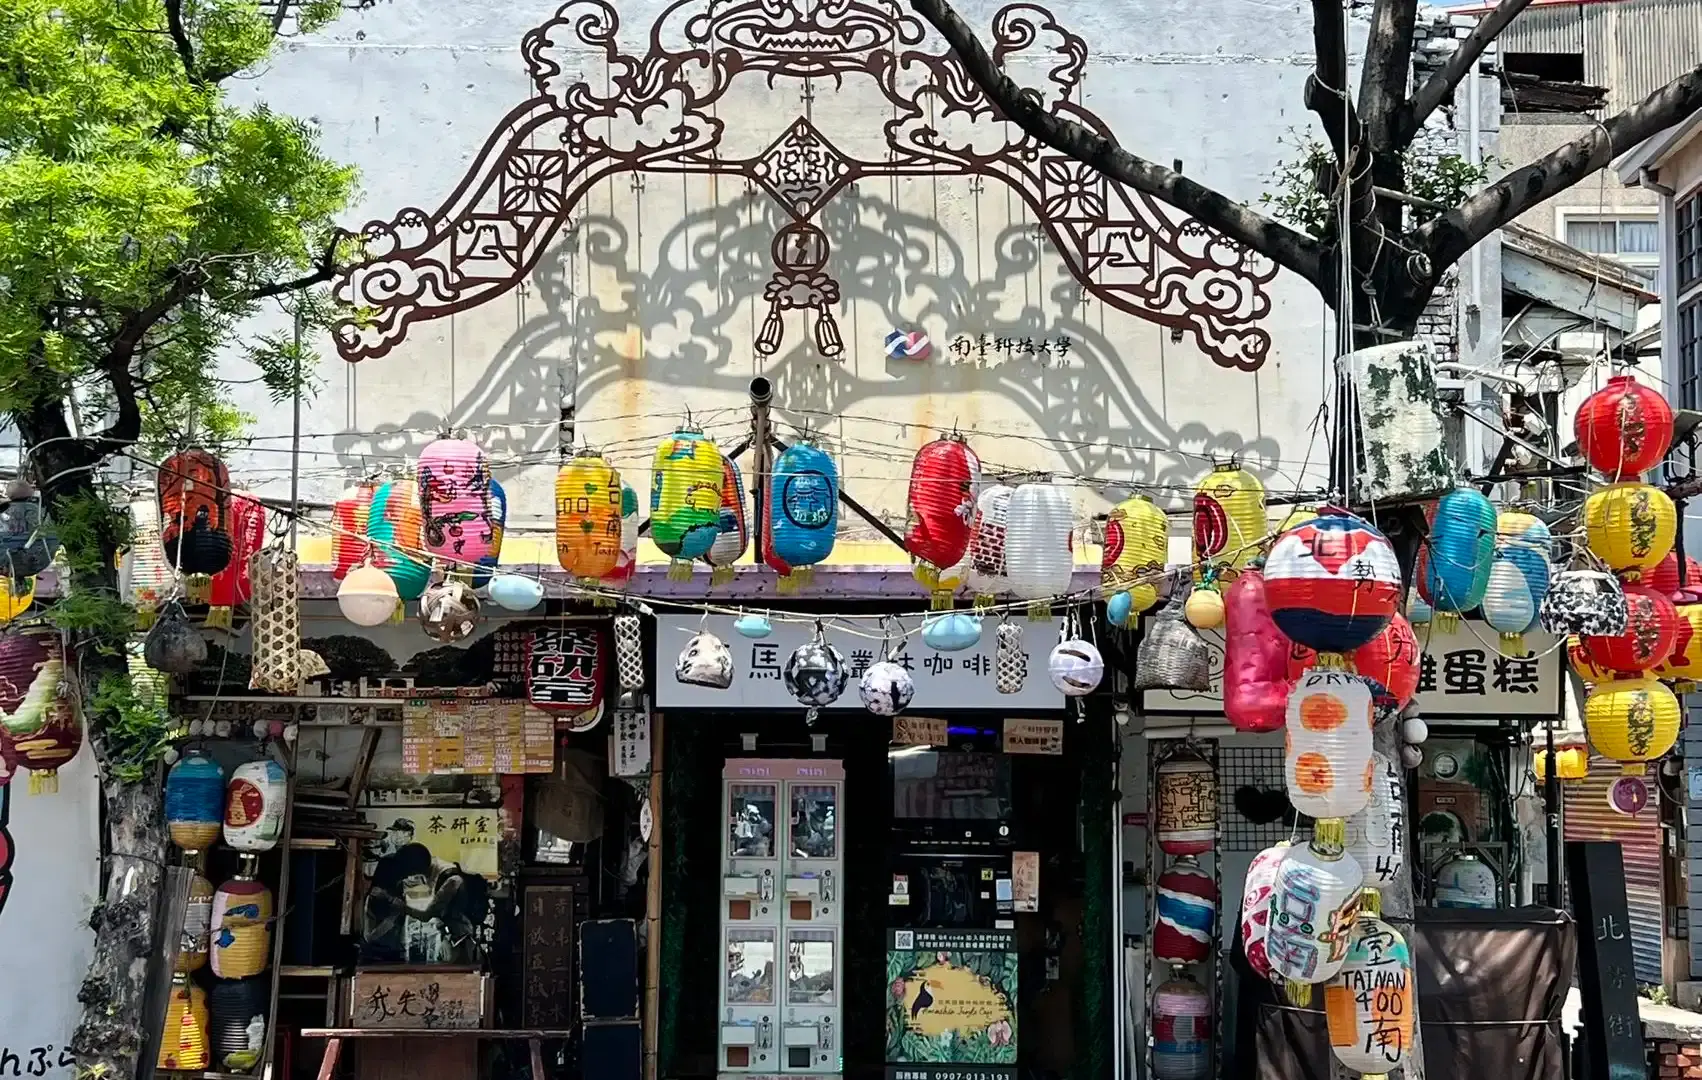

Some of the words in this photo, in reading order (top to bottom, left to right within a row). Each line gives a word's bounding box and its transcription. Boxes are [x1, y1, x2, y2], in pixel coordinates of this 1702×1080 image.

[428, 814, 491, 835] 茶研室
[1356, 919, 1396, 966] 臺
[1342, 969, 1406, 992] TAINAN
[1355, 992, 1403, 1016] 400
[1363, 1018, 1401, 1062] 南
